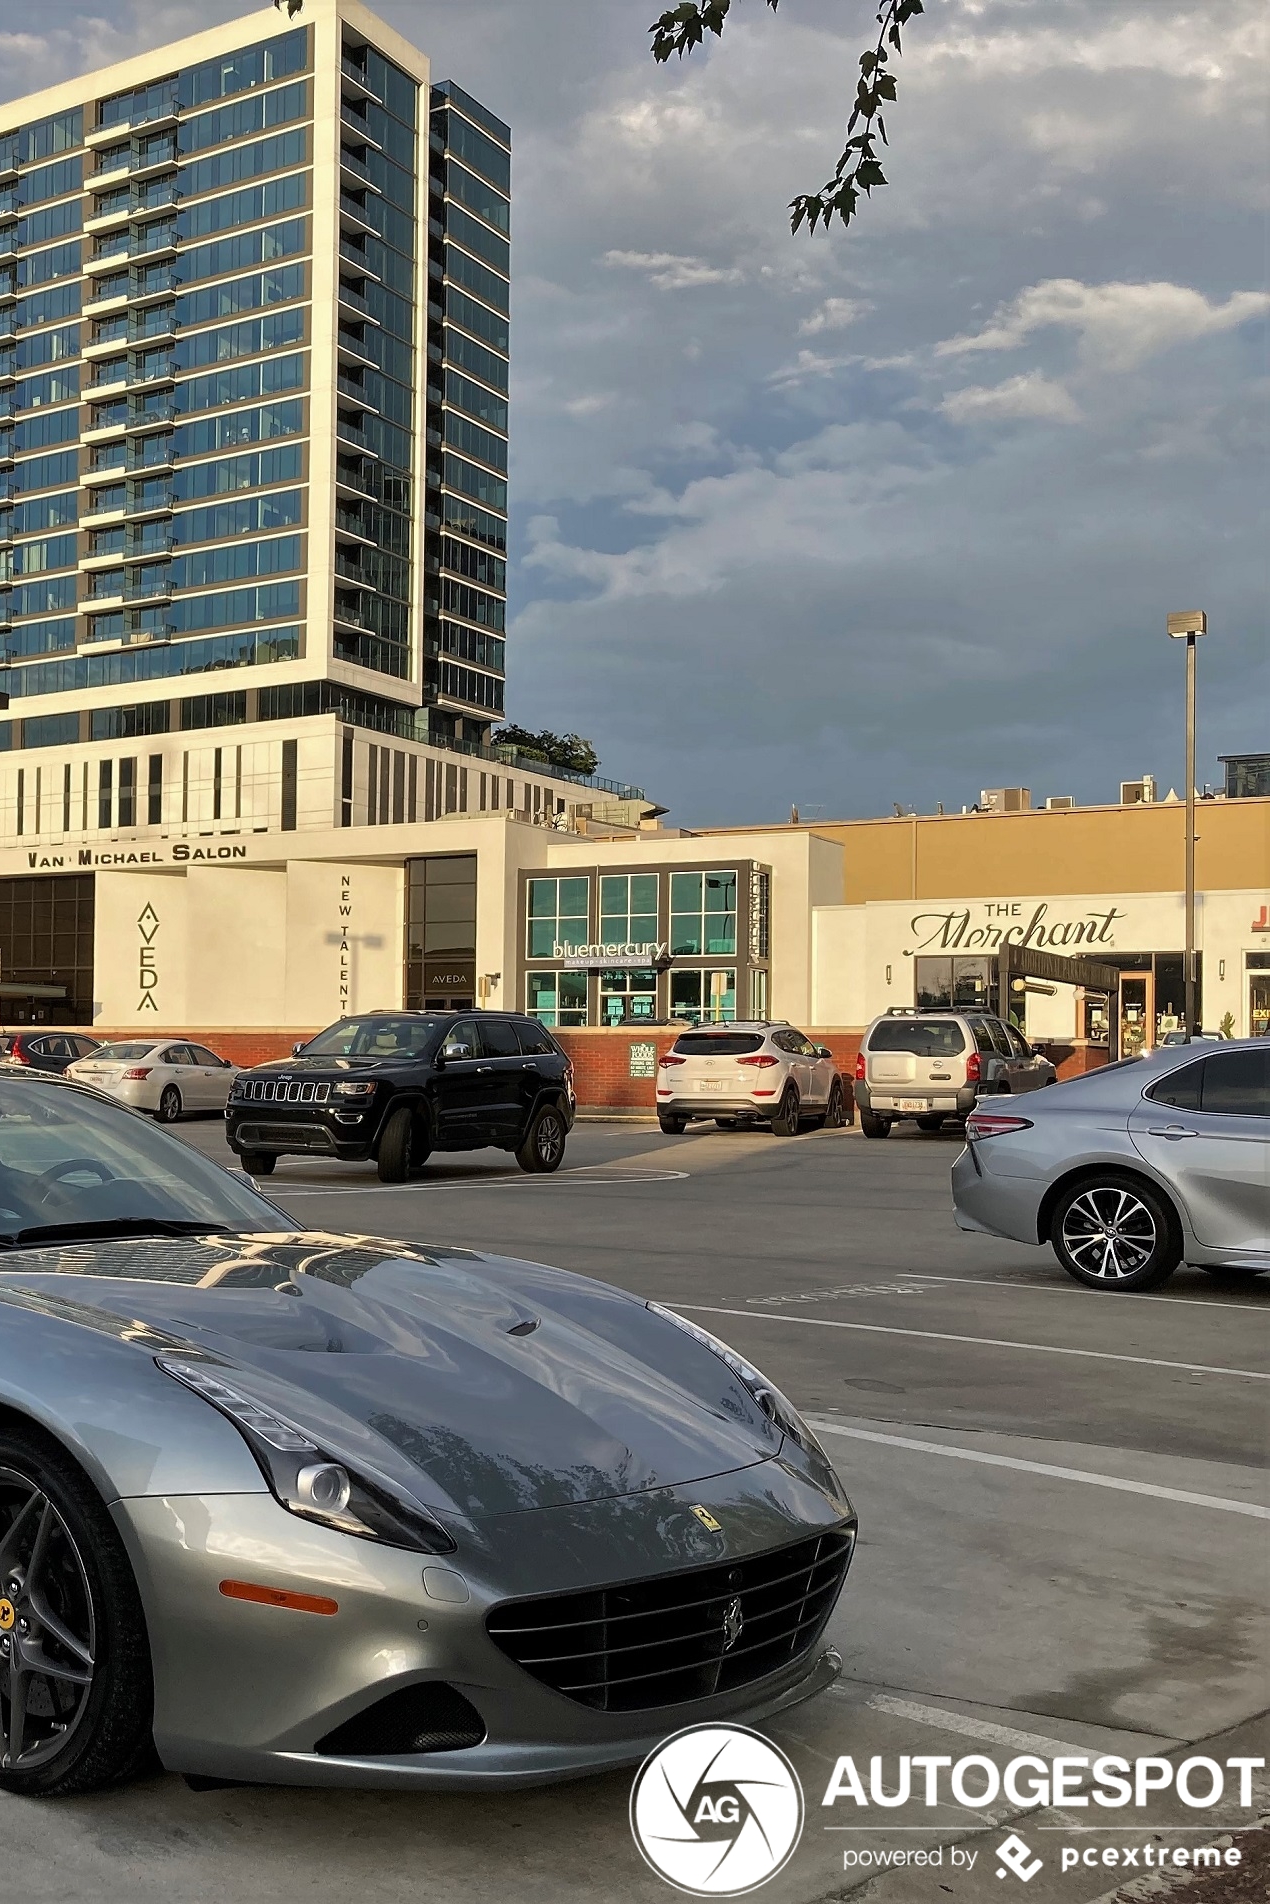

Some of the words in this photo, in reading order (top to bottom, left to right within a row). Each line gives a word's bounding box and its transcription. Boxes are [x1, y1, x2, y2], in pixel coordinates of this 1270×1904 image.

[28, 852, 64, 868] VAN
[78, 849, 164, 866] MICHAEL
[172, 844, 247, 861] SALON
[339, 875, 352, 916] NEW
[984, 903, 1022, 917] THE
[902, 903, 1128, 957] Merchant
[137, 901, 160, 1011] AVEDA
[552, 939, 668, 960] bluemercury
[565, 958, 594, 966] makeup
[599, 957, 633, 965] skincare
[637, 957, 651, 965] spa
[432, 975, 467, 983] AVEDA
[630, 1044, 655, 1053] WHOLE
